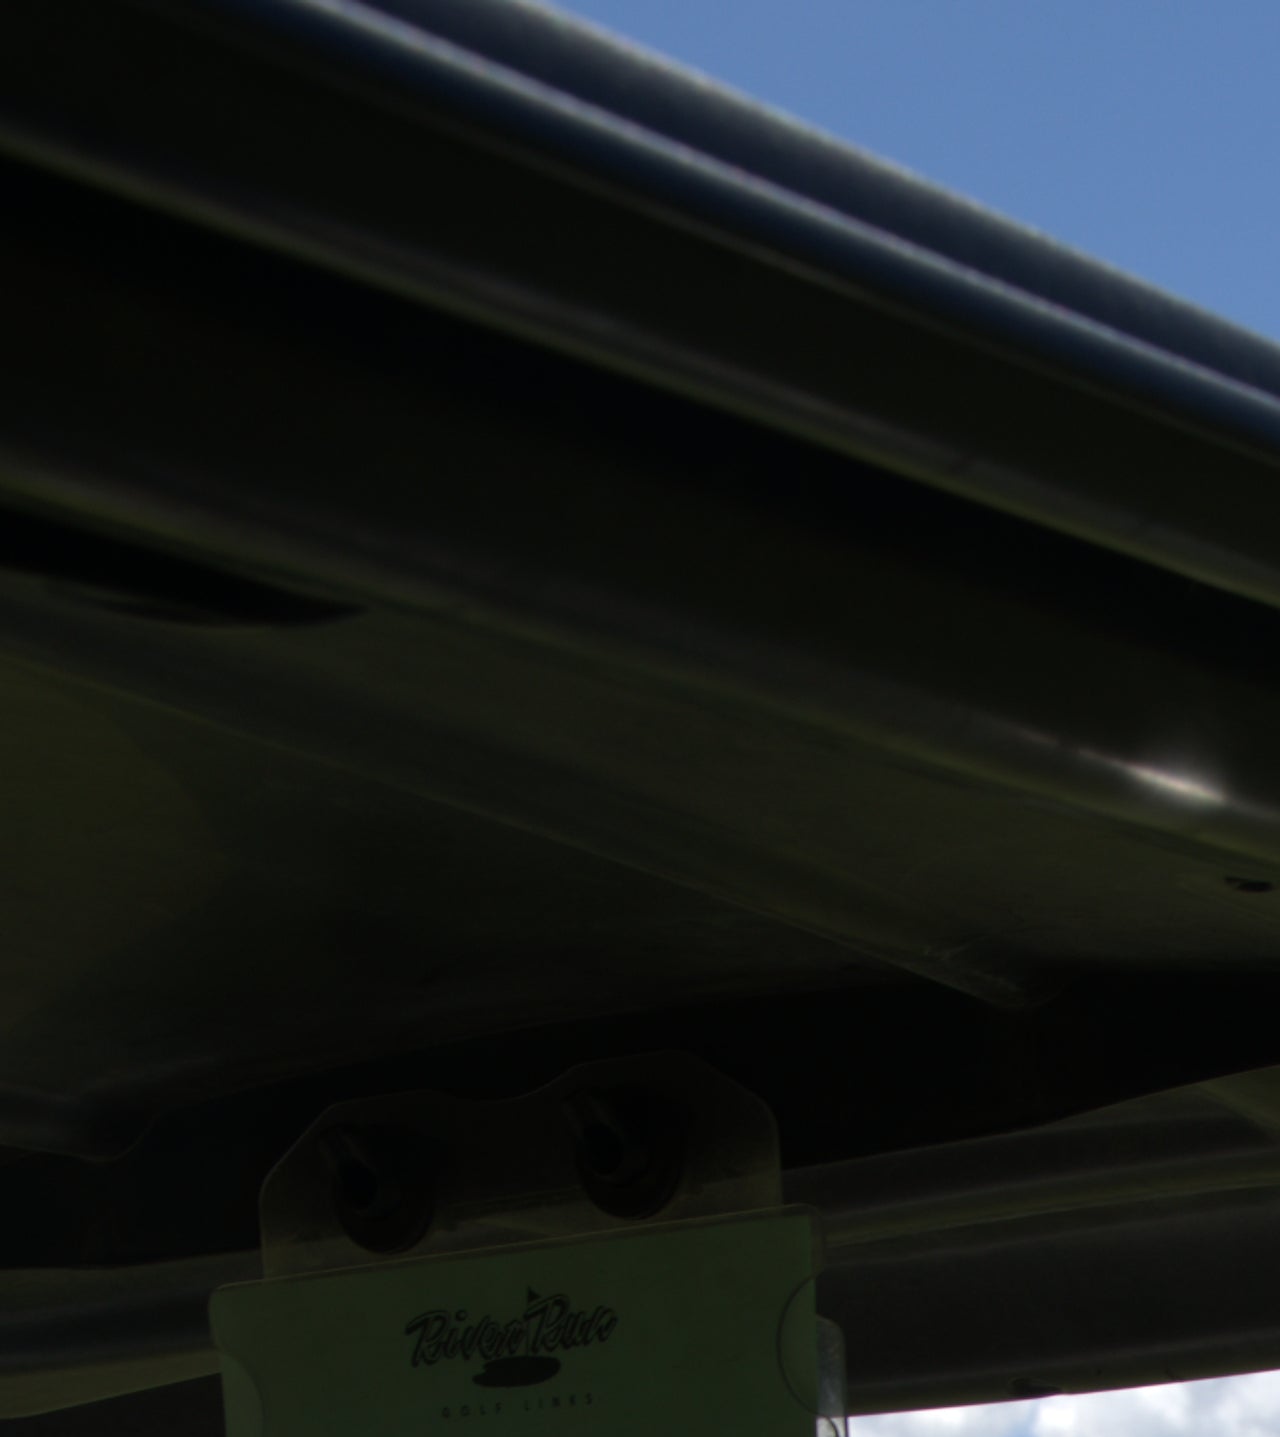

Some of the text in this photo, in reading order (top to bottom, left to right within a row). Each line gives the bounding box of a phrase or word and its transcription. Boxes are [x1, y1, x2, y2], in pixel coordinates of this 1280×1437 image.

[405, 1294, 617, 1367] River Run
[441, 1393, 593, 1418] GOLF LINKS
